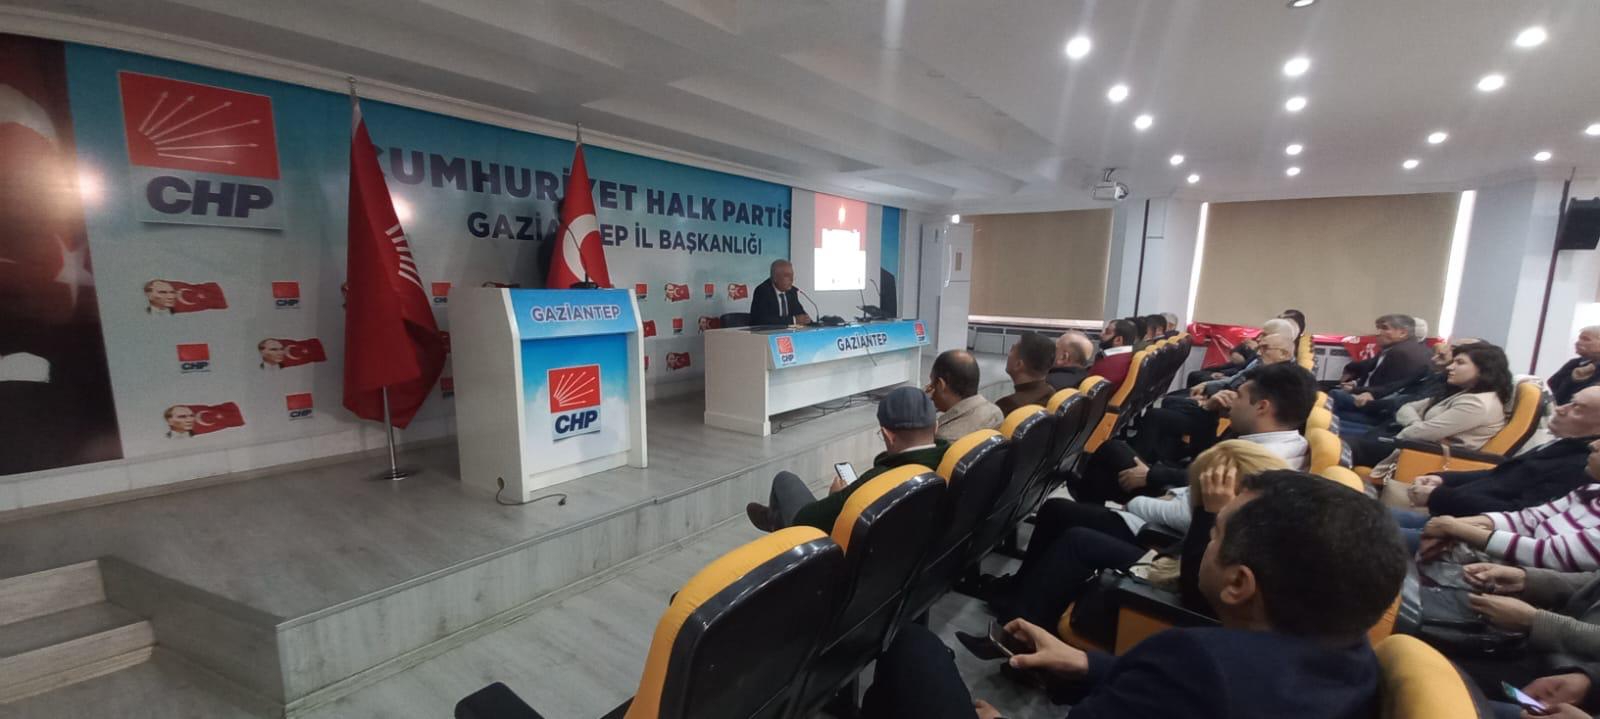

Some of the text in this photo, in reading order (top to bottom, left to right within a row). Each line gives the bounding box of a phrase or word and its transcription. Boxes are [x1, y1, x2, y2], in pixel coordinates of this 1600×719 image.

[374, 143, 638, 211] UMHURİET
[646, 188, 717, 221] HALK
[146, 175, 274, 218] CHP
[635, 221, 654, 249] İL
[659, 228, 762, 255] BAŞKANLIĞI
[531, 302, 620, 322] GAZİANTEP
[837, 332, 887, 352] GAZİANTEP
[181, 361, 209, 371] CHP
[554, 409, 598, 434] CHP
